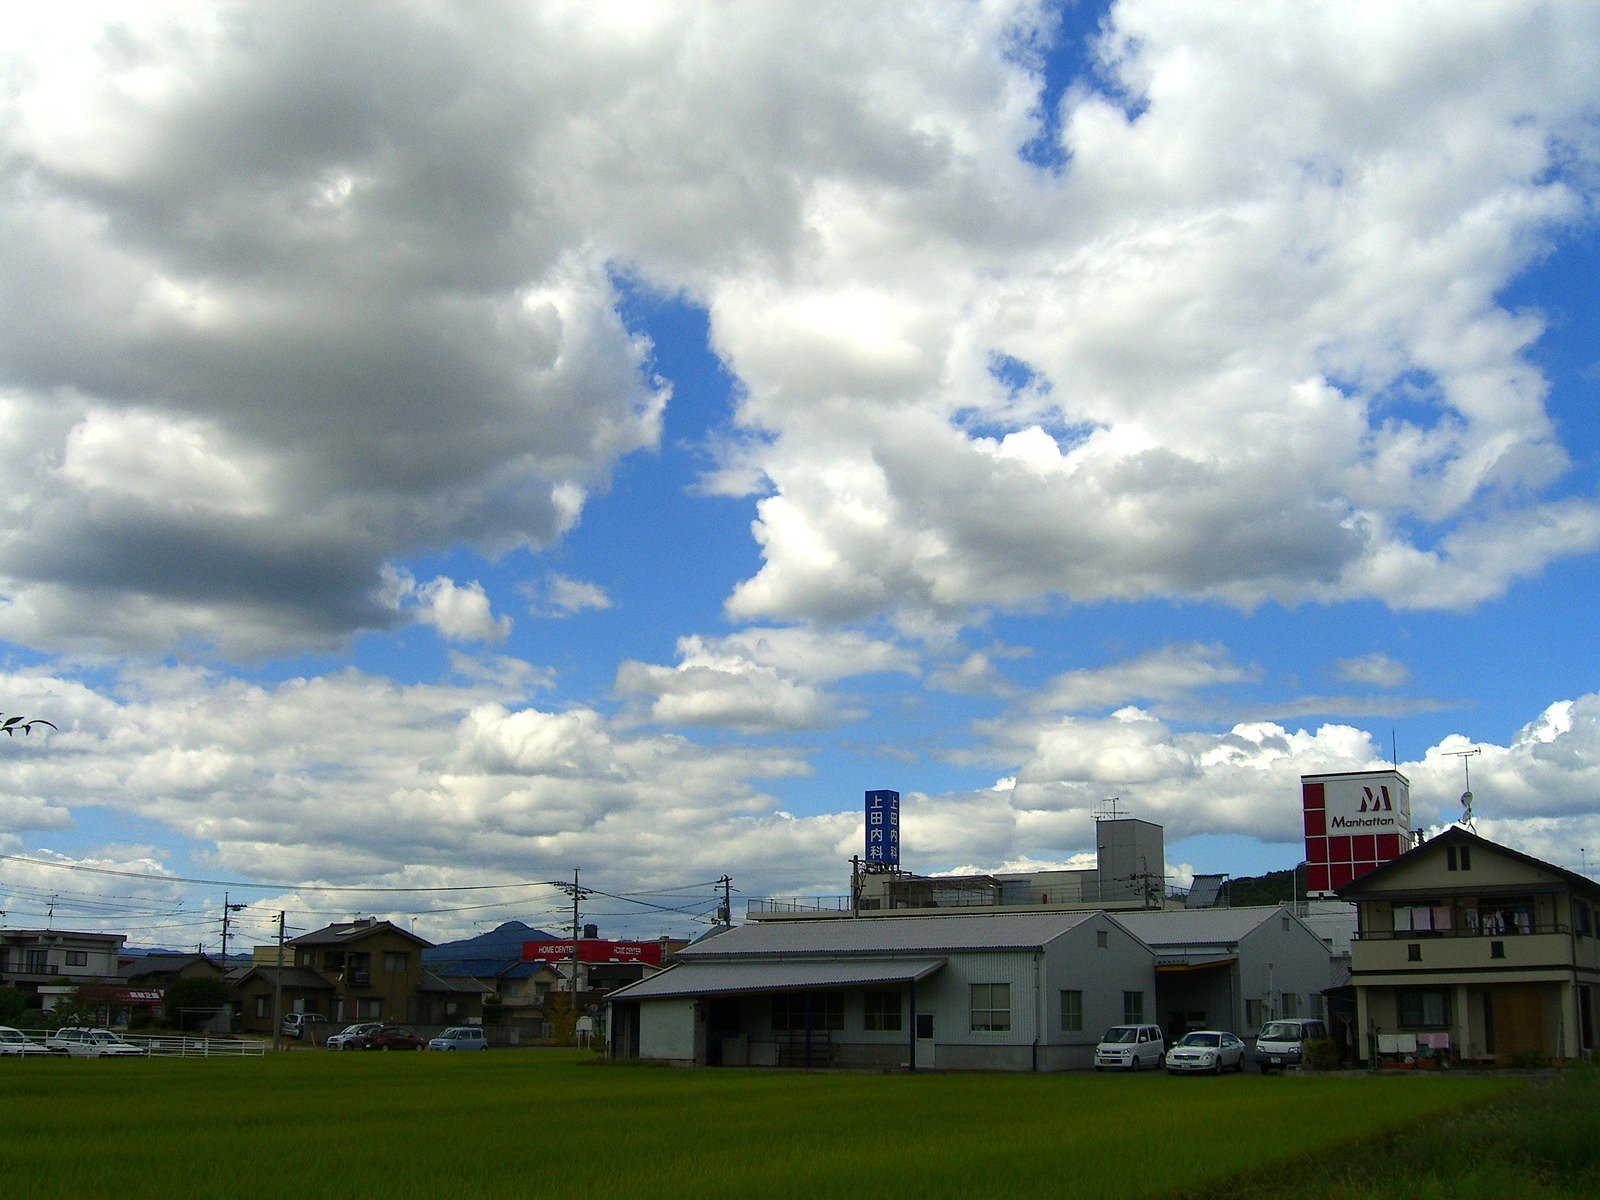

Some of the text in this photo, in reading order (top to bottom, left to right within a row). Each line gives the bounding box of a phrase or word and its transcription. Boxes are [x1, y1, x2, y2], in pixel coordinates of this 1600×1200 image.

[870, 795, 883, 860] 上田内科
[890, 796, 898, 860] 上田内科
[1331, 816, 1395, 828] Manhattan
[538, 945, 574, 954] HOME CENTE
[613, 946, 641, 955] HOME CENTER
